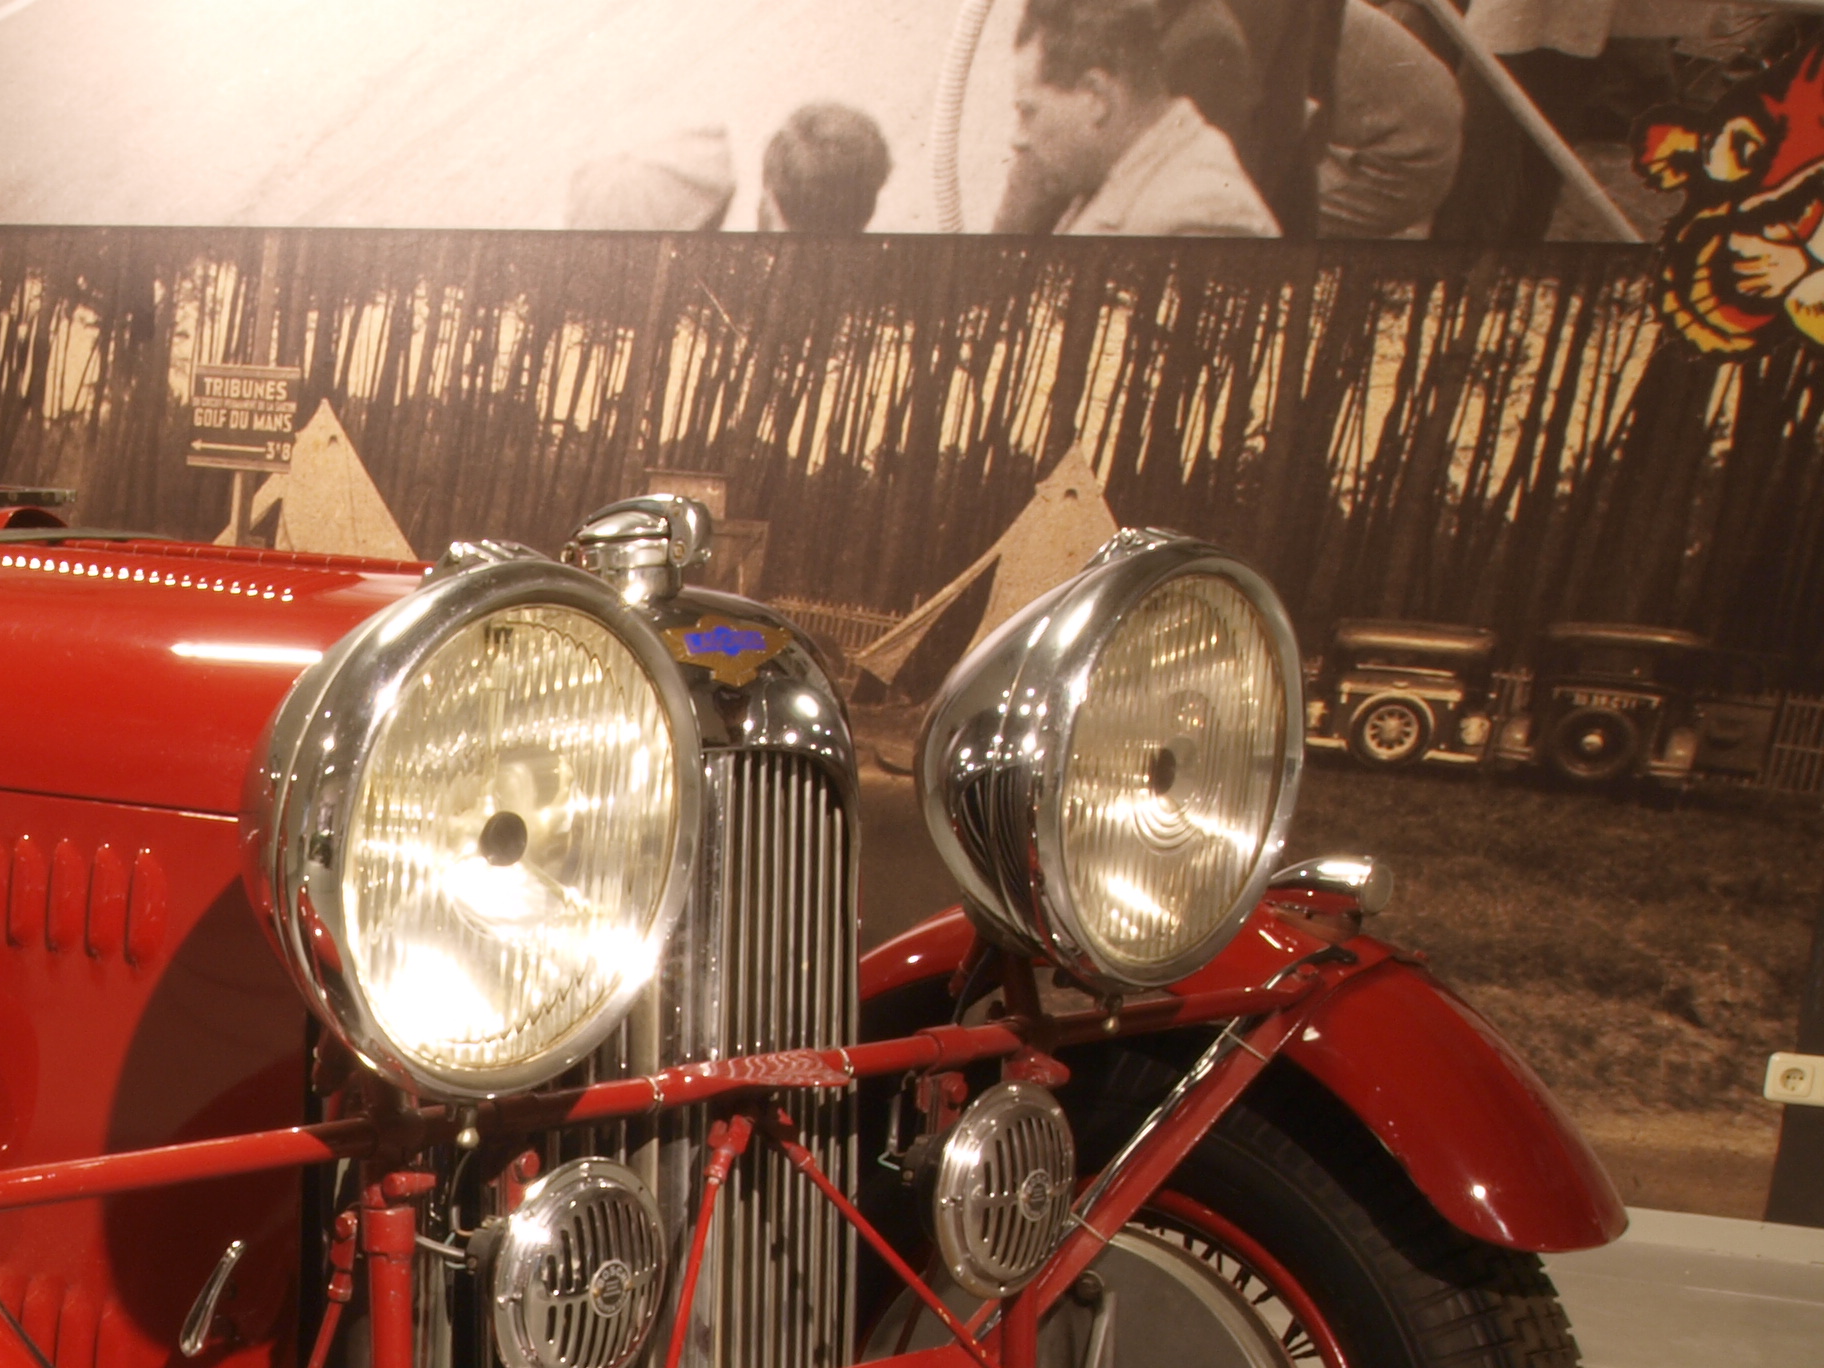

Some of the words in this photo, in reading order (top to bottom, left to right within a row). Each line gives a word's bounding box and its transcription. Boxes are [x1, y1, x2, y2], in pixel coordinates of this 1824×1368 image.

[204, 376, 288, 401] TRIBUNES
[193, 407, 228, 428] GOLF
[229, 409, 250, 430] DU
[252, 412, 293, 433] MANS
